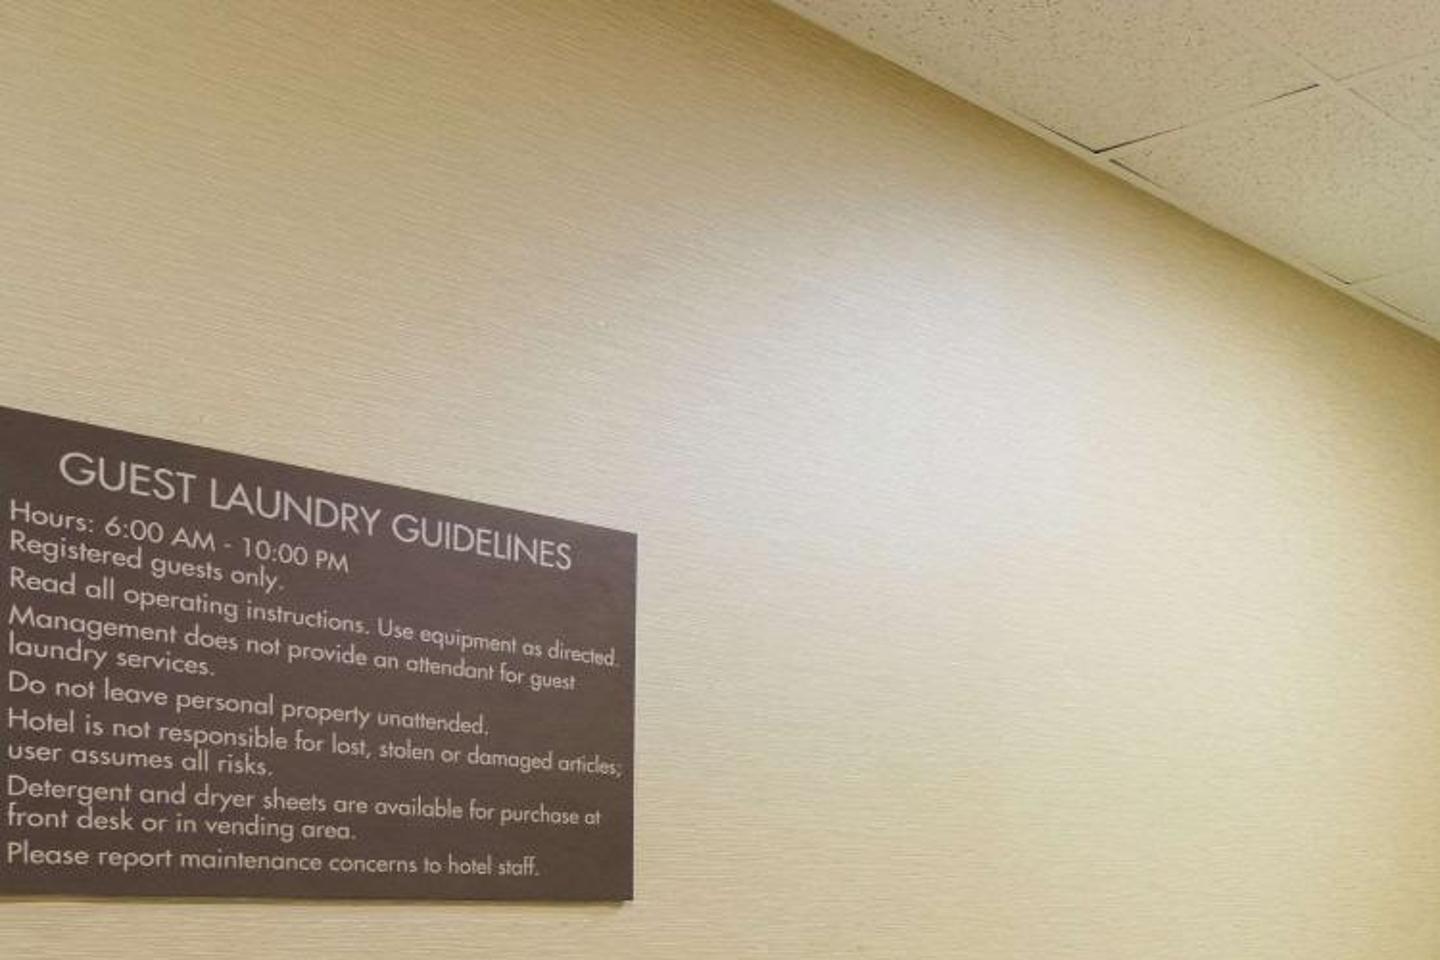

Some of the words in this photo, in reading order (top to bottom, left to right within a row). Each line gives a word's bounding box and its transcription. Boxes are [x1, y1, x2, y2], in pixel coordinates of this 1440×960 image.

[10, 498, 94, 533] Hours:
[104, 515, 165, 544] 6:00
[170, 526, 216, 552] AM
[242, 536, 309, 566] 10:00
[315, 549, 349, 574] PM
[58, 451, 198, 504] GUEST
[210, 477, 382, 537] LAUNDRY
[391, 513, 572, 571] GUIDELINES
[9, 528, 143, 570] Registered
[150, 557, 224, 582] guests
[230, 564, 284, 595] only.
[9, 565, 76, 596] Read
[84, 575, 115, 601] all
[123, 589, 239, 623] operating
[246, 599, 370, 635] instructions.
[377, 617, 414, 641] Use
[419, 628, 517, 654] equipment
[521, 642, 543, 658] as
[7, 603, 178, 644] Management
[183, 623, 239, 651] does
[246, 638, 281, 656] not
[287, 643, 368, 667] provide
[373, 655, 399, 670] an
[405, 656, 495, 681] attendant
[499, 661, 525, 684] for
[529, 673, 576, 692] guest
[8, 629, 108, 671] laundry
[115, 650, 215, 677] services.
[8, 669, 47, 695] Do
[55, 680, 96, 700] not
[104, 676, 169, 706] leave
[175, 692, 274, 716] personal
[281, 703, 371, 730] property
[377, 711, 489, 736] unattended.
[7, 706, 75, 734] Hotel
[85, 713, 104, 737] is
[112, 721, 151, 739] not
[158, 724, 288, 750] responsible
[294, 728, 325, 752] for
[331, 732, 372, 760] lost,
[379, 738, 435, 761] stolen
[440, 749, 462, 763] or
[467, 743, 554, 774] damaged
[7, 743, 63, 763] user
[70, 748, 174, 769] assumes
[181, 748, 209, 773] all
[6, 773, 133, 807] Detergent
[139, 781, 186, 805] and
[193, 782, 256, 813] dryer
[262, 786, 327, 812] sheets
[333, 799, 368, 814] are
[373, 794, 464, 819] available
[469, 797, 496, 820] for
[500, 802, 580, 827] purchase
[583, 810, 602, 825] at
[7, 801, 69, 829] front
[76, 804, 134, 831] desk
[141, 817, 169, 833] or
[176, 812, 197, 833] in
[204, 813, 295, 844] vending
[301, 824, 356, 840] area.
[7, 838, 90, 866] Please
[98, 849, 174, 873] report
[180, 847, 323, 871] maintenance
[328, 857, 418, 873] concerns
[423, 857, 442, 874] to
[448, 852, 493, 875] hotel
[498, 855, 540, 877] staff.
